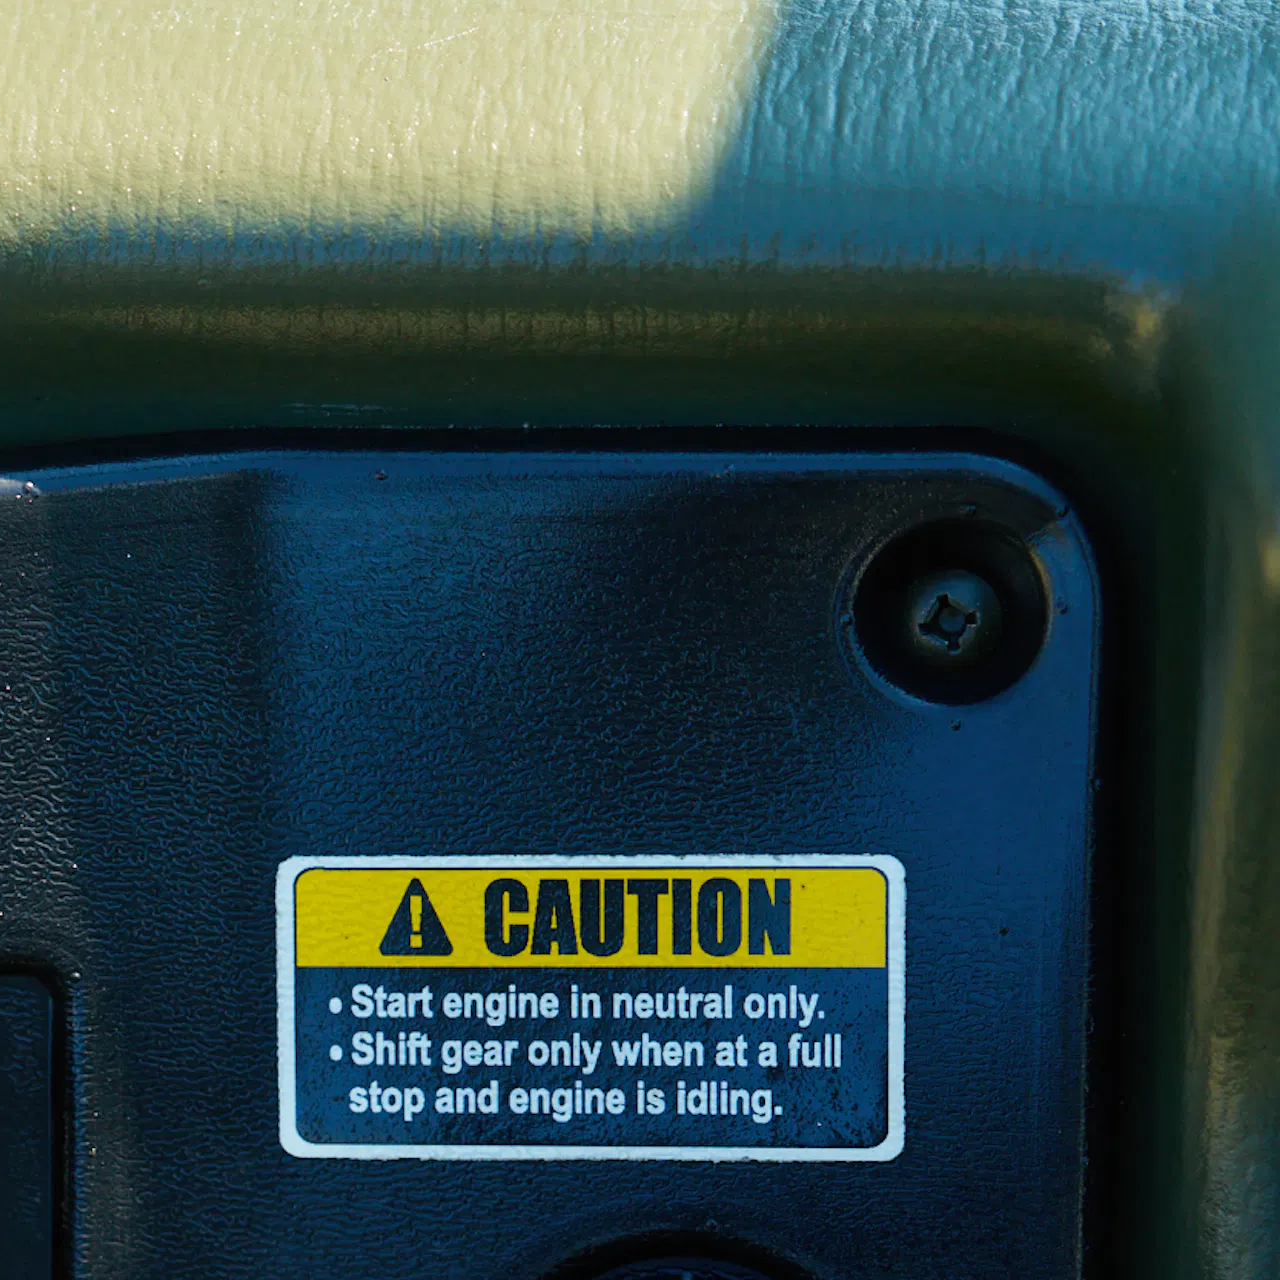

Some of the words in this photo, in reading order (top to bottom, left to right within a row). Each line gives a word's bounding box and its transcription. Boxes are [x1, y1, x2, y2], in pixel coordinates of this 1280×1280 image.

[485, 878, 791, 957] CAUTION
[351, 984, 433, 1018] Start
[443, 985, 559, 1024] engine
[571, 985, 601, 1018] in
[613, 985, 732, 1018] neutral
[744, 985, 824, 1024] only.
[352, 1032, 431, 1065] Shift
[442, 1041, 519, 1074] gear
[528, 1033, 602, 1074] only
[612, 1033, 704, 1066] when
[716, 1035, 747, 1066] at
[759, 1042, 777, 1067] a
[788, 1033, 841, 1067] full
[349, 1081, 425, 1121] stop
[435, 1080, 498, 1113] and
[510, 1081, 625, 1122] engine
[638, 1081, 665, 1114] is
[678, 1081, 782, 1123] idling.
